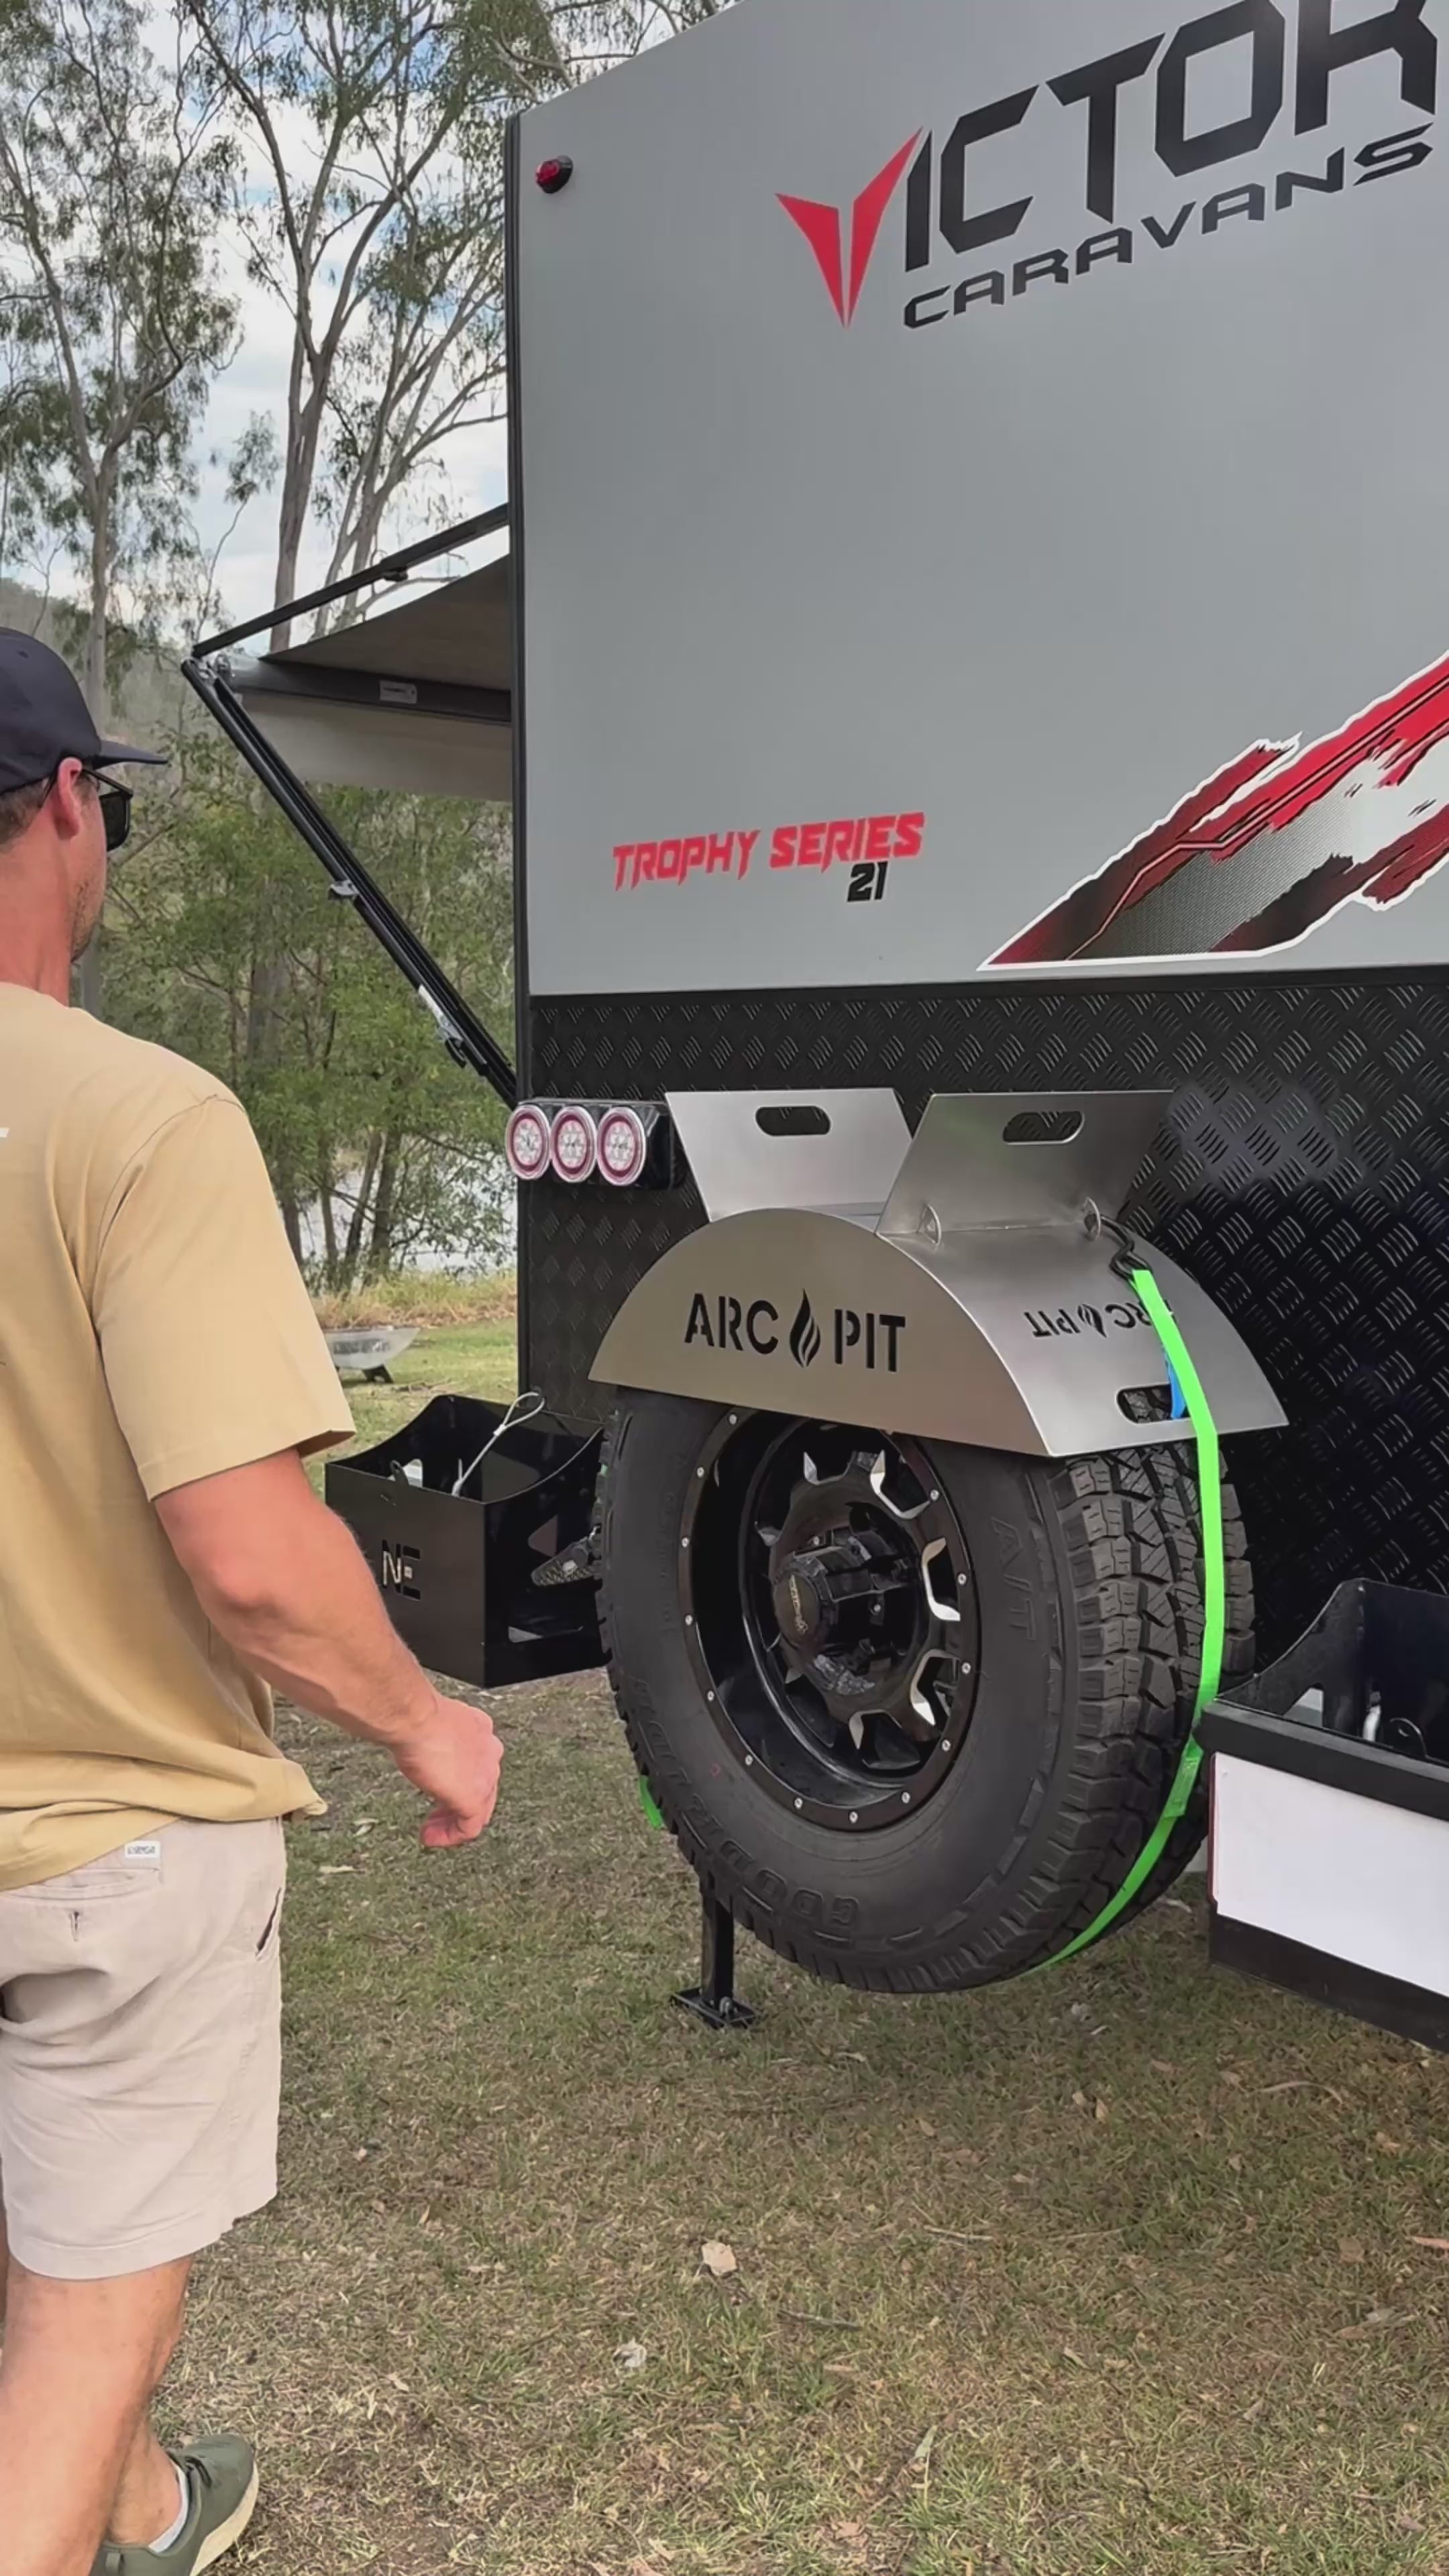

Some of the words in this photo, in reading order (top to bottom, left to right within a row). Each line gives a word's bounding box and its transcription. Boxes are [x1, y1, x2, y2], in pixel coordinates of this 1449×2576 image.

[903, 122, 1434, 329] CARAVANS
[612, 829, 761, 891] TROPHY
[769, 812, 925, 873] SERIES
[847, 861, 888, 902] 21
[684, 1293, 779, 1355] ARC
[834, 1309, 906, 1373] PIT
[1023, 1308, 1081, 1338] PIT
